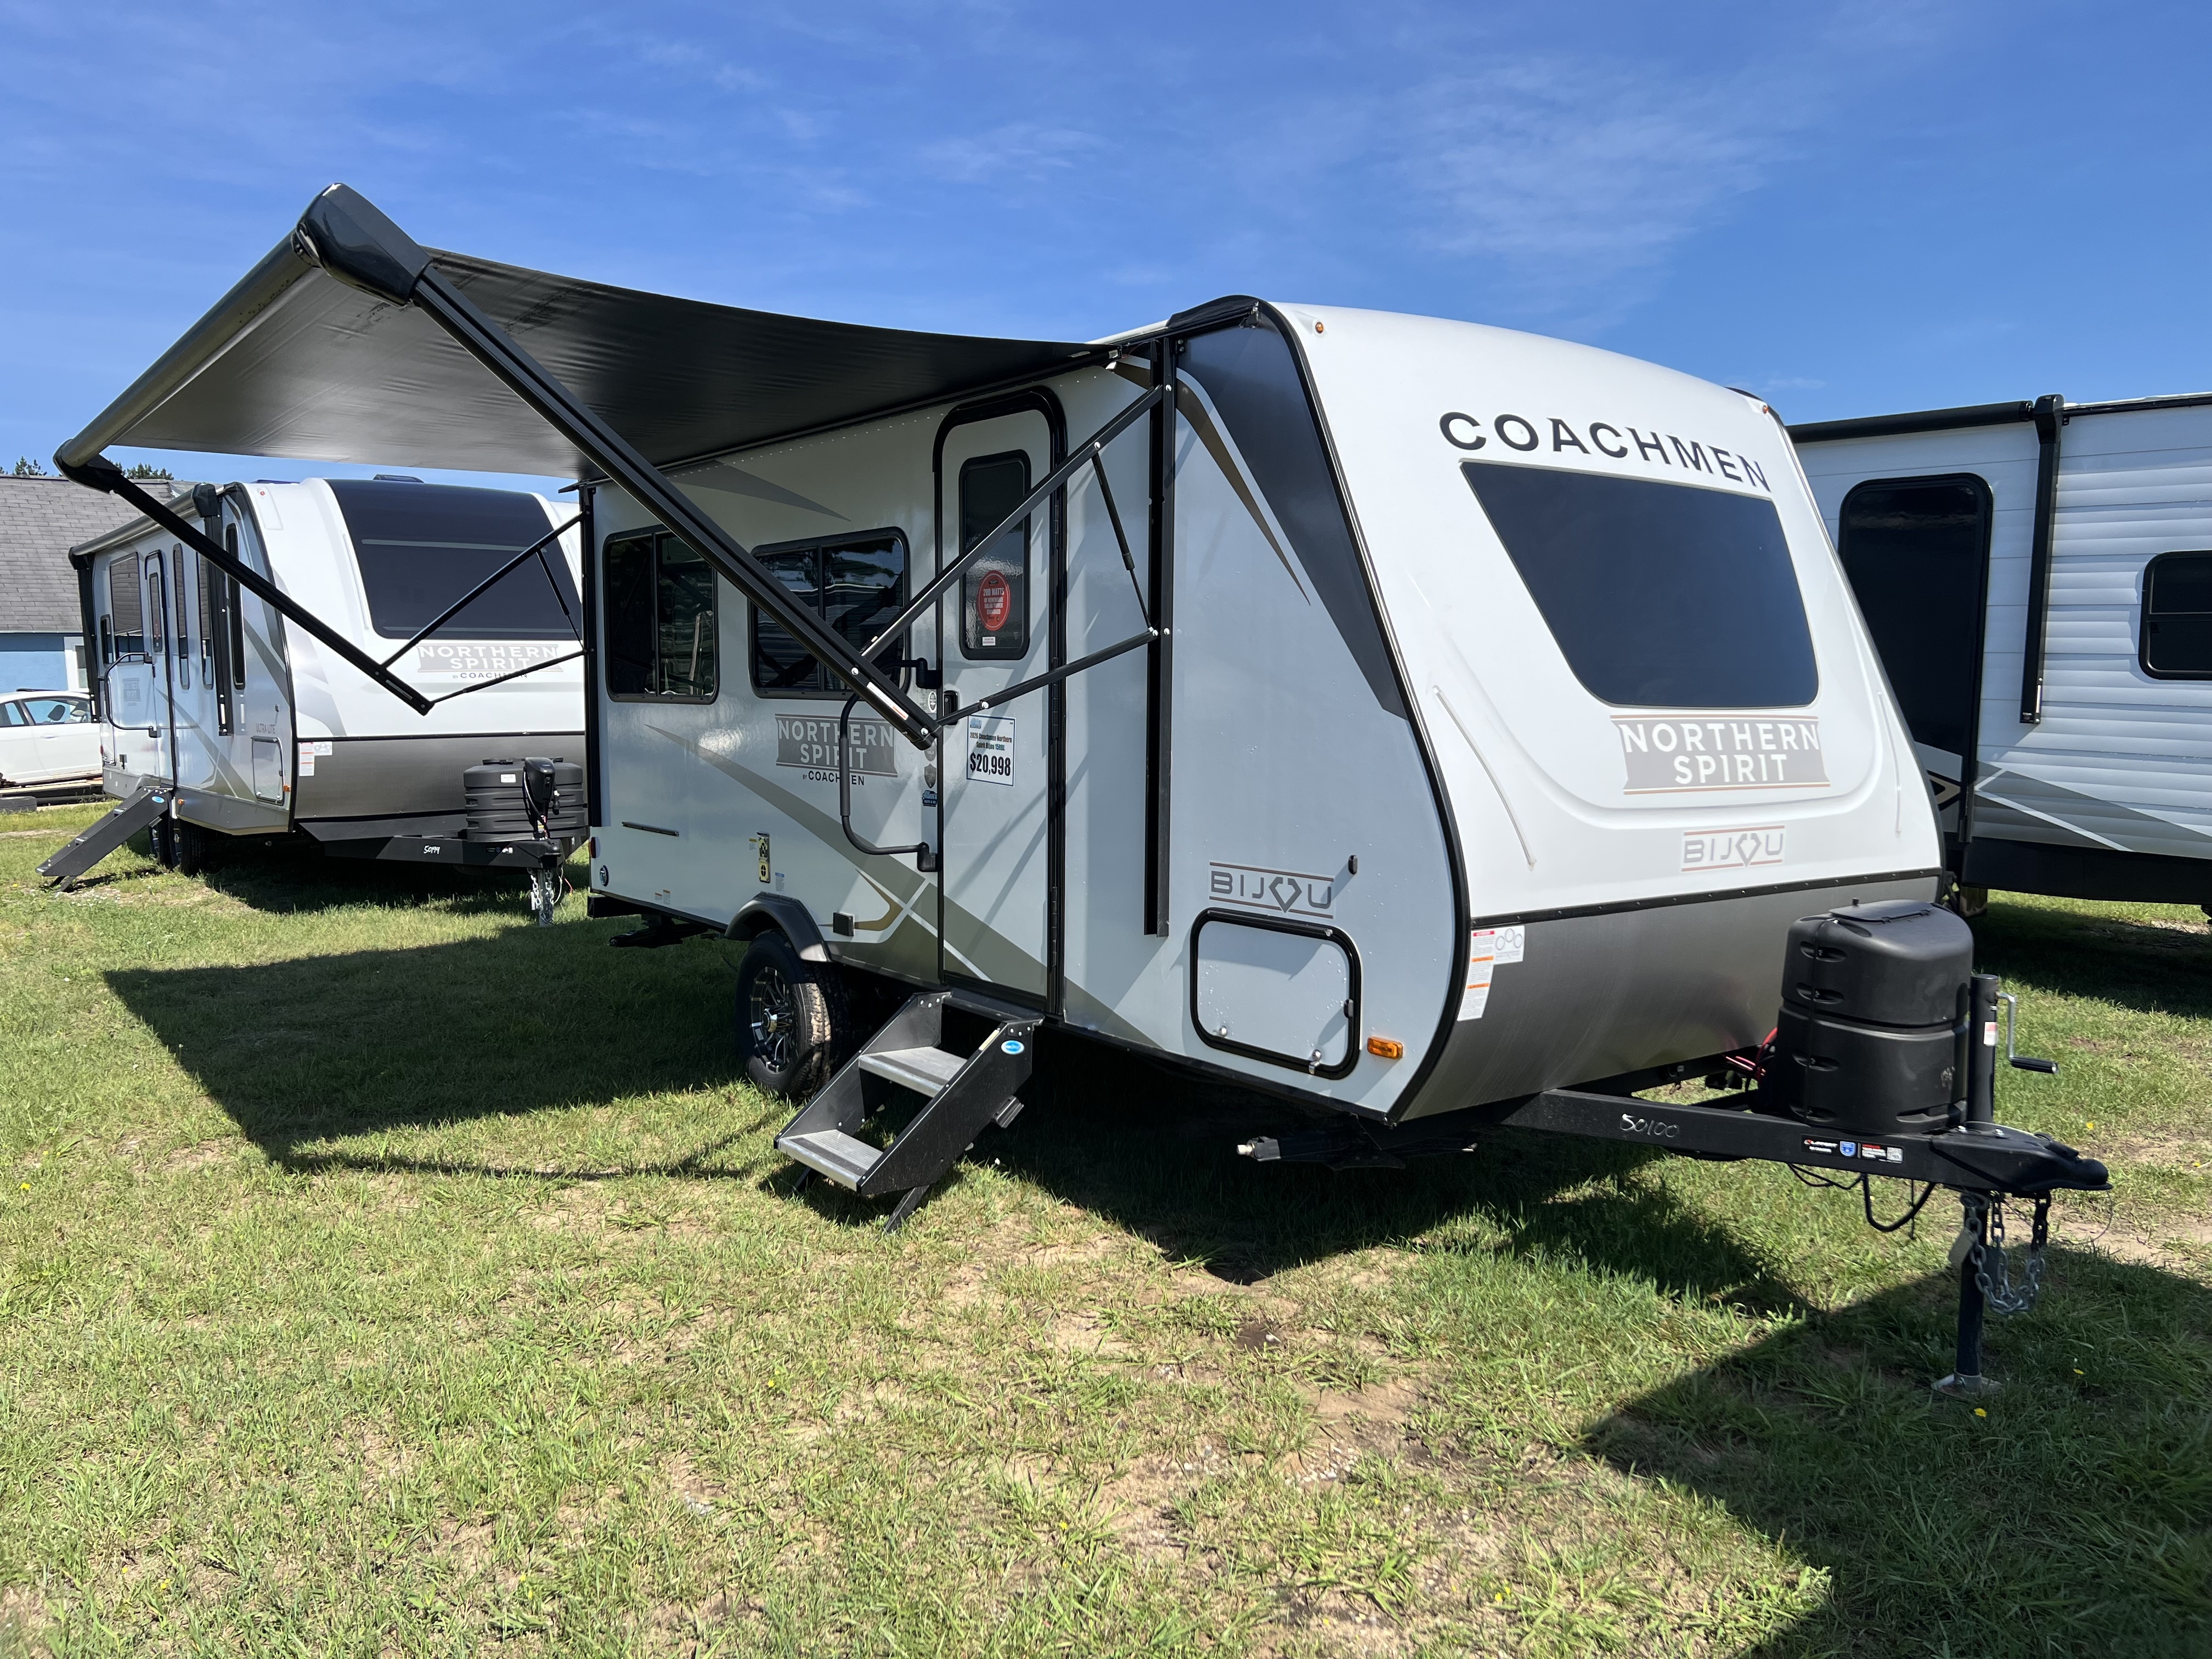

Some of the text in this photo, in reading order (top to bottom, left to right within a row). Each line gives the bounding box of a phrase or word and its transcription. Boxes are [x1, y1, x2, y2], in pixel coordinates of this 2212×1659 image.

[1439, 411, 1772, 493] COACHMEN
[983, 588, 1005, 596] 200 WATTS
[420, 646, 558, 658] NORTHERN
[450, 658, 531, 669] SPIRIT
[256, 723, 267, 734] ULTRA
[1620, 722, 1819, 753] NORTHERN
[970, 752, 1011, 776] $20,998
[1674, 753, 1787, 784] SPIRIT
[808, 770, 865, 786] COACHEN
[1684, 832, 1784, 867] BIJOU
[1210, 870, 1331, 913] BIJOU
[1620, 1114, 1679, 1137] 50100
